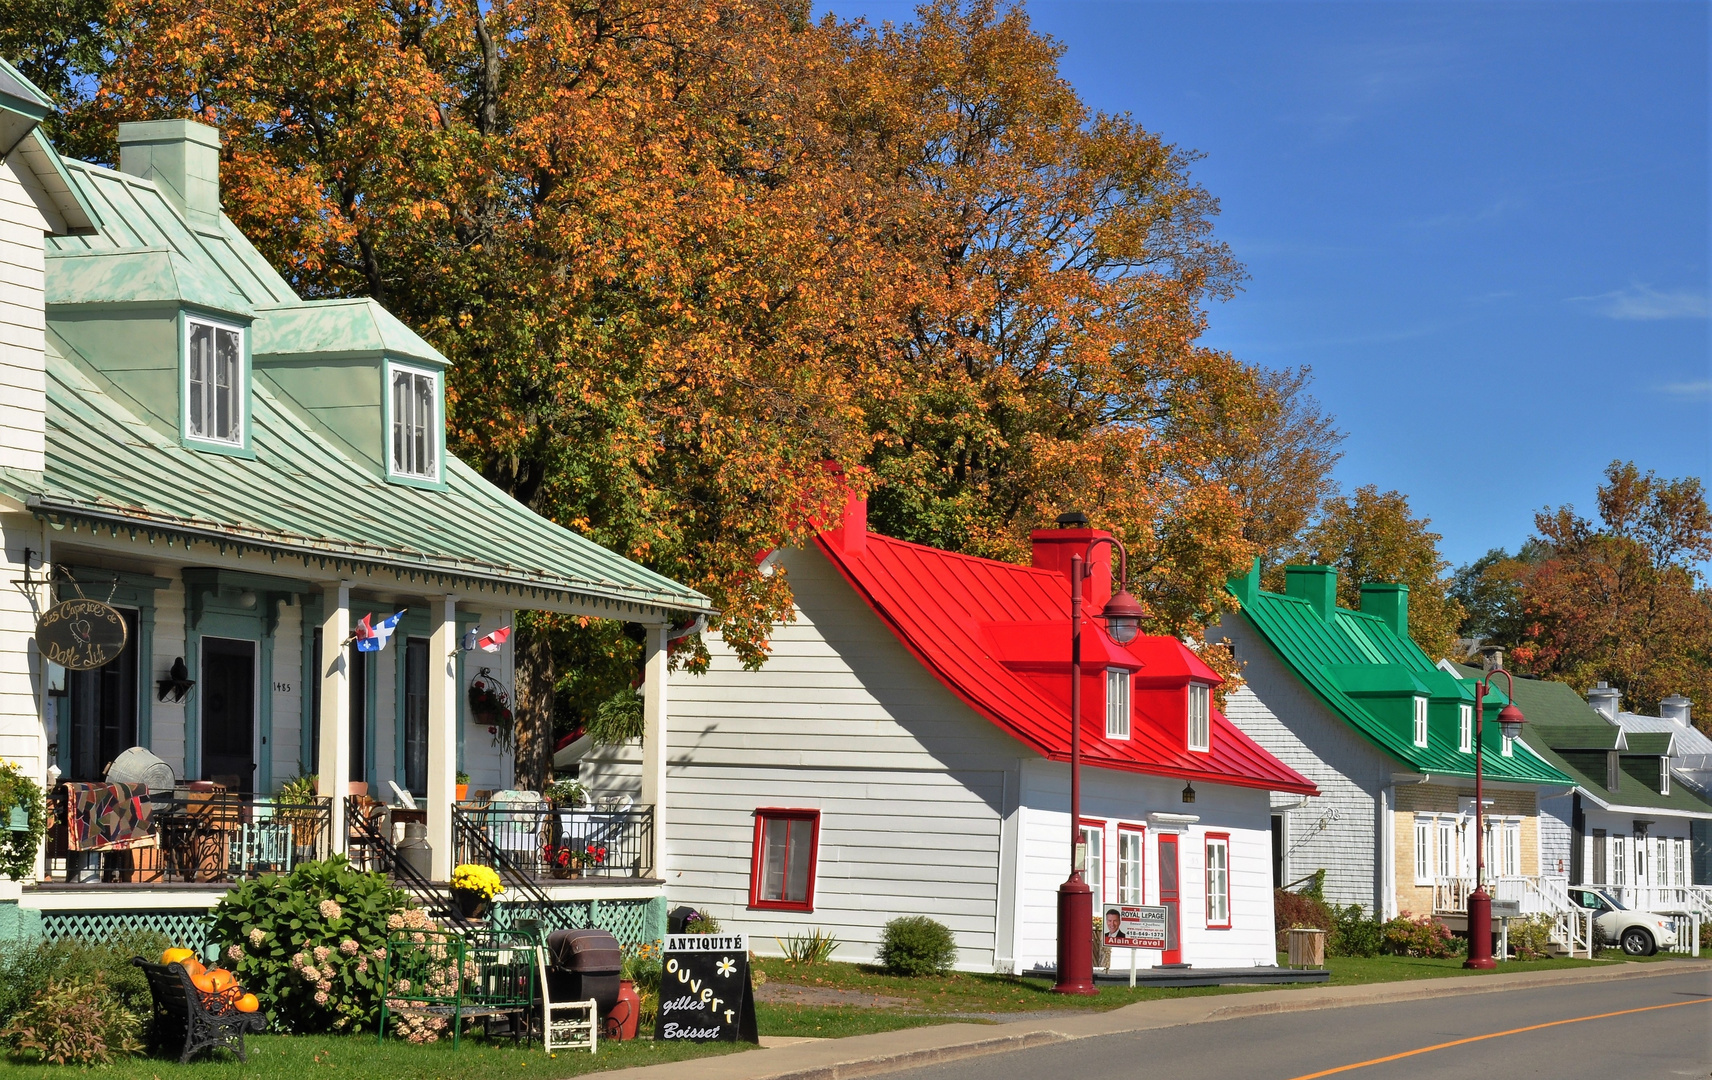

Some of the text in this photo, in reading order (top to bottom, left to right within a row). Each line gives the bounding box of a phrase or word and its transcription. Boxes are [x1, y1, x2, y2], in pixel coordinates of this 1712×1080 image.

[43, 601, 117, 627] Les Caprices de
[273, 682, 291, 692] 1485
[669, 934, 742, 950] ANTIQUITÉ
[1108, 937, 1130, 945] Alain
[1132, 938, 1161, 946] Gravel
[663, 995, 706, 1016] gilles
[663, 1022, 721, 1039] Boisset
